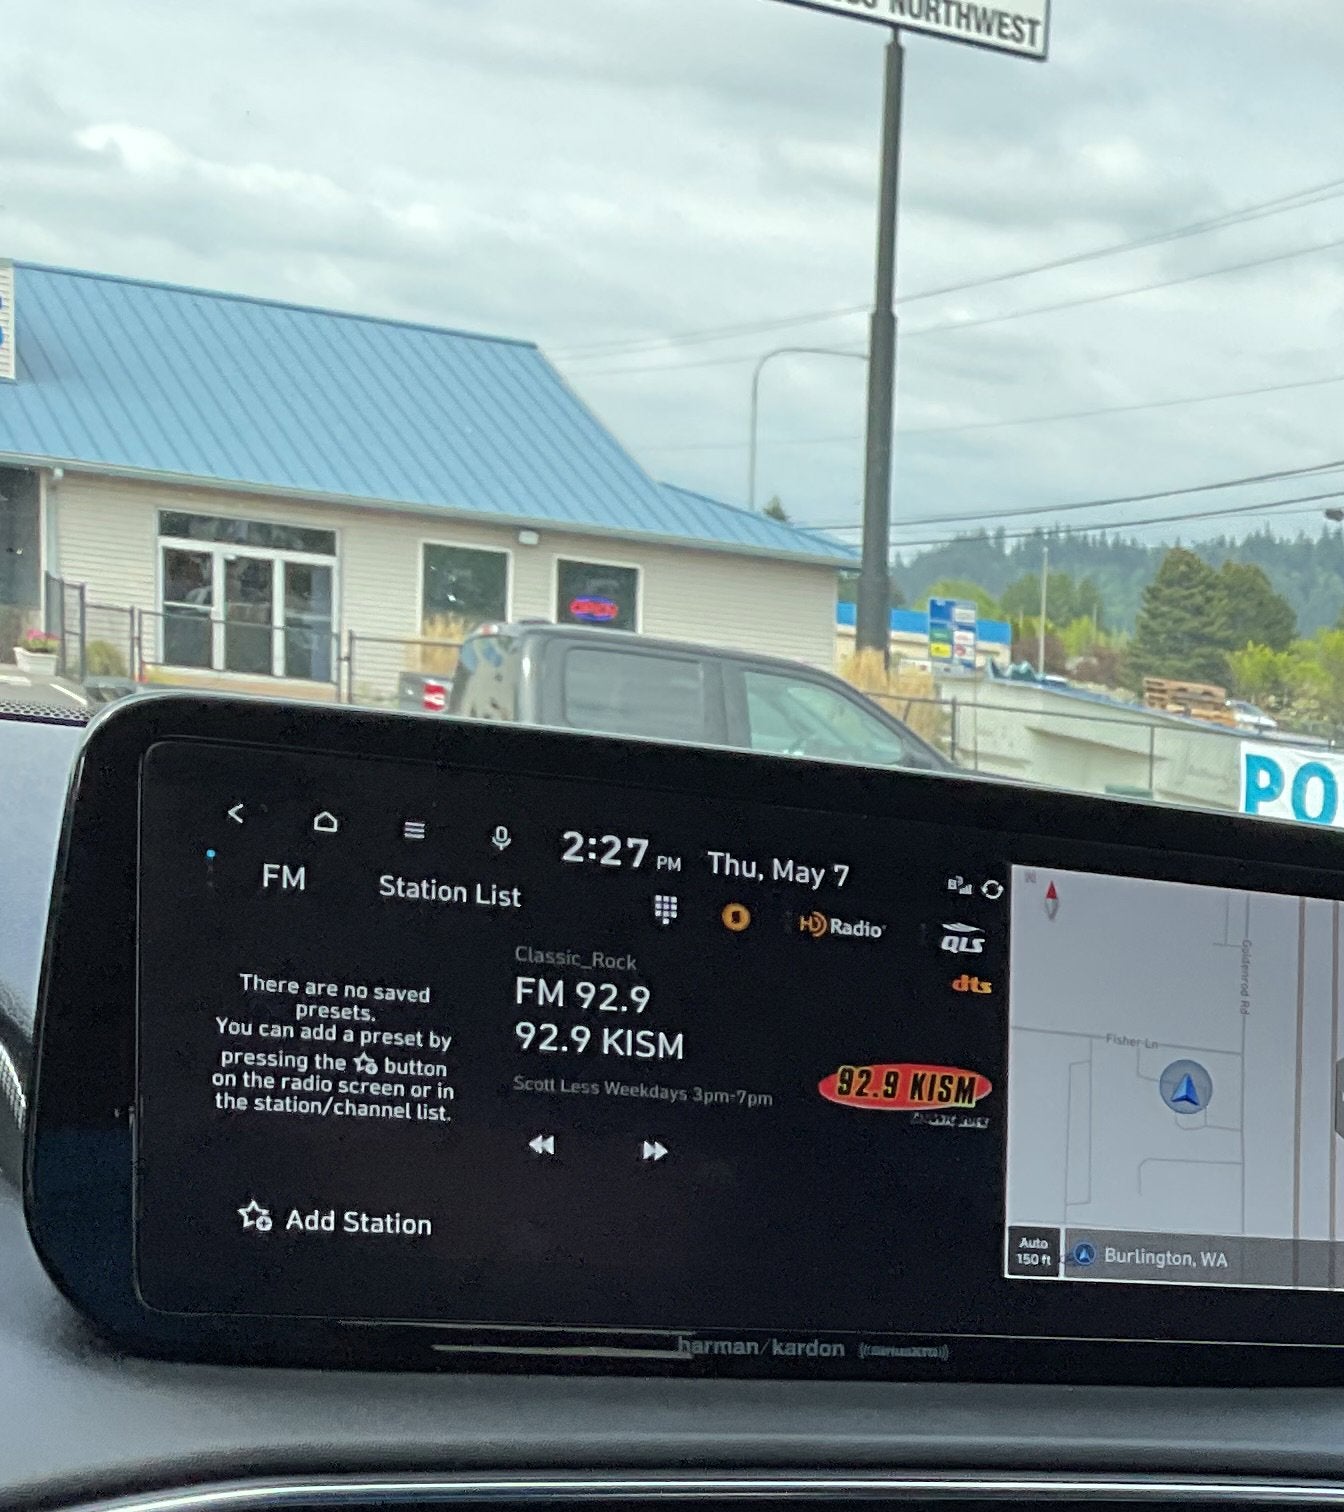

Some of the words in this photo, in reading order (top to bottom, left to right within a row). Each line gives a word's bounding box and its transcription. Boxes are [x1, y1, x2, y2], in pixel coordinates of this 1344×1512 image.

[562, 830, 649, 868] 2:27
[656, 856, 682, 872] PM
[263, 863, 305, 890] FM
[707, 850, 764, 881] Thu,
[773, 858, 825, 890] May
[833, 864, 850, 887] 7
[379, 875, 467, 902] Station
[475, 883, 522, 907] List
[830, 918, 883, 938] Radio
[515, 945, 637, 971] Classic_Rock
[240, 973, 299, 994] There
[305, 981, 338, 997] are
[344, 984, 368, 999] no
[374, 987, 430, 1003] saved
[516, 976, 564, 1007] FM
[575, 981, 651, 1013] 92.9
[951, 974, 993, 994] dts
[295, 1003, 376, 1022] presets.
[1240, 1000, 1250, 1015] Rd
[216, 1017, 252, 1036] You
[259, 1023, 294, 1038] can
[300, 1024, 336, 1041] add
[343, 1029, 354, 1042] a
[360, 1030, 423, 1047] preset
[429, 1032, 452, 1051] by
[515, 1021, 591, 1052] 92.9
[602, 1027, 684, 1060] KISM
[1106, 1033, 1141, 1047] Fisher
[1145, 1038, 1159, 1049] Ln
[221, 1051, 308, 1072] pressing
[315, 1054, 346, 1071] the
[384, 1058, 447, 1077] button
[212, 1072, 236, 1087] on
[242, 1072, 275, 1089] the
[281, 1075, 332, 1092] radio
[338, 1081, 404, 1097] screen
[411, 1085, 431, 1098] or
[437, 1082, 454, 1100] in
[513, 1075, 555, 1093] Scott
[560, 1078, 599, 1094] Less
[604, 1080, 688, 1103] Weekdays
[693, 1087, 773, 1107] 3pm-7pm
[836, 1066, 900, 1099] 92.9
[909, 1070, 976, 1106] KISM
[215, 1093, 247, 1110] the
[254, 1097, 411, 1119] station/channel
[416, 1103, 451, 1122] list.
[286, 1209, 335, 1232] Add
[343, 1211, 432, 1235] Station
[1018, 1237, 1048, 1249] Auto
[1017, 1253, 1039, 1265] 150
[1041, 1254, 1051, 1266] ft
[1104, 1248, 1197, 1269] Burlington,
[1200, 1252, 1228, 1268] WA
[678, 1336, 845, 1357] harman/kardon
